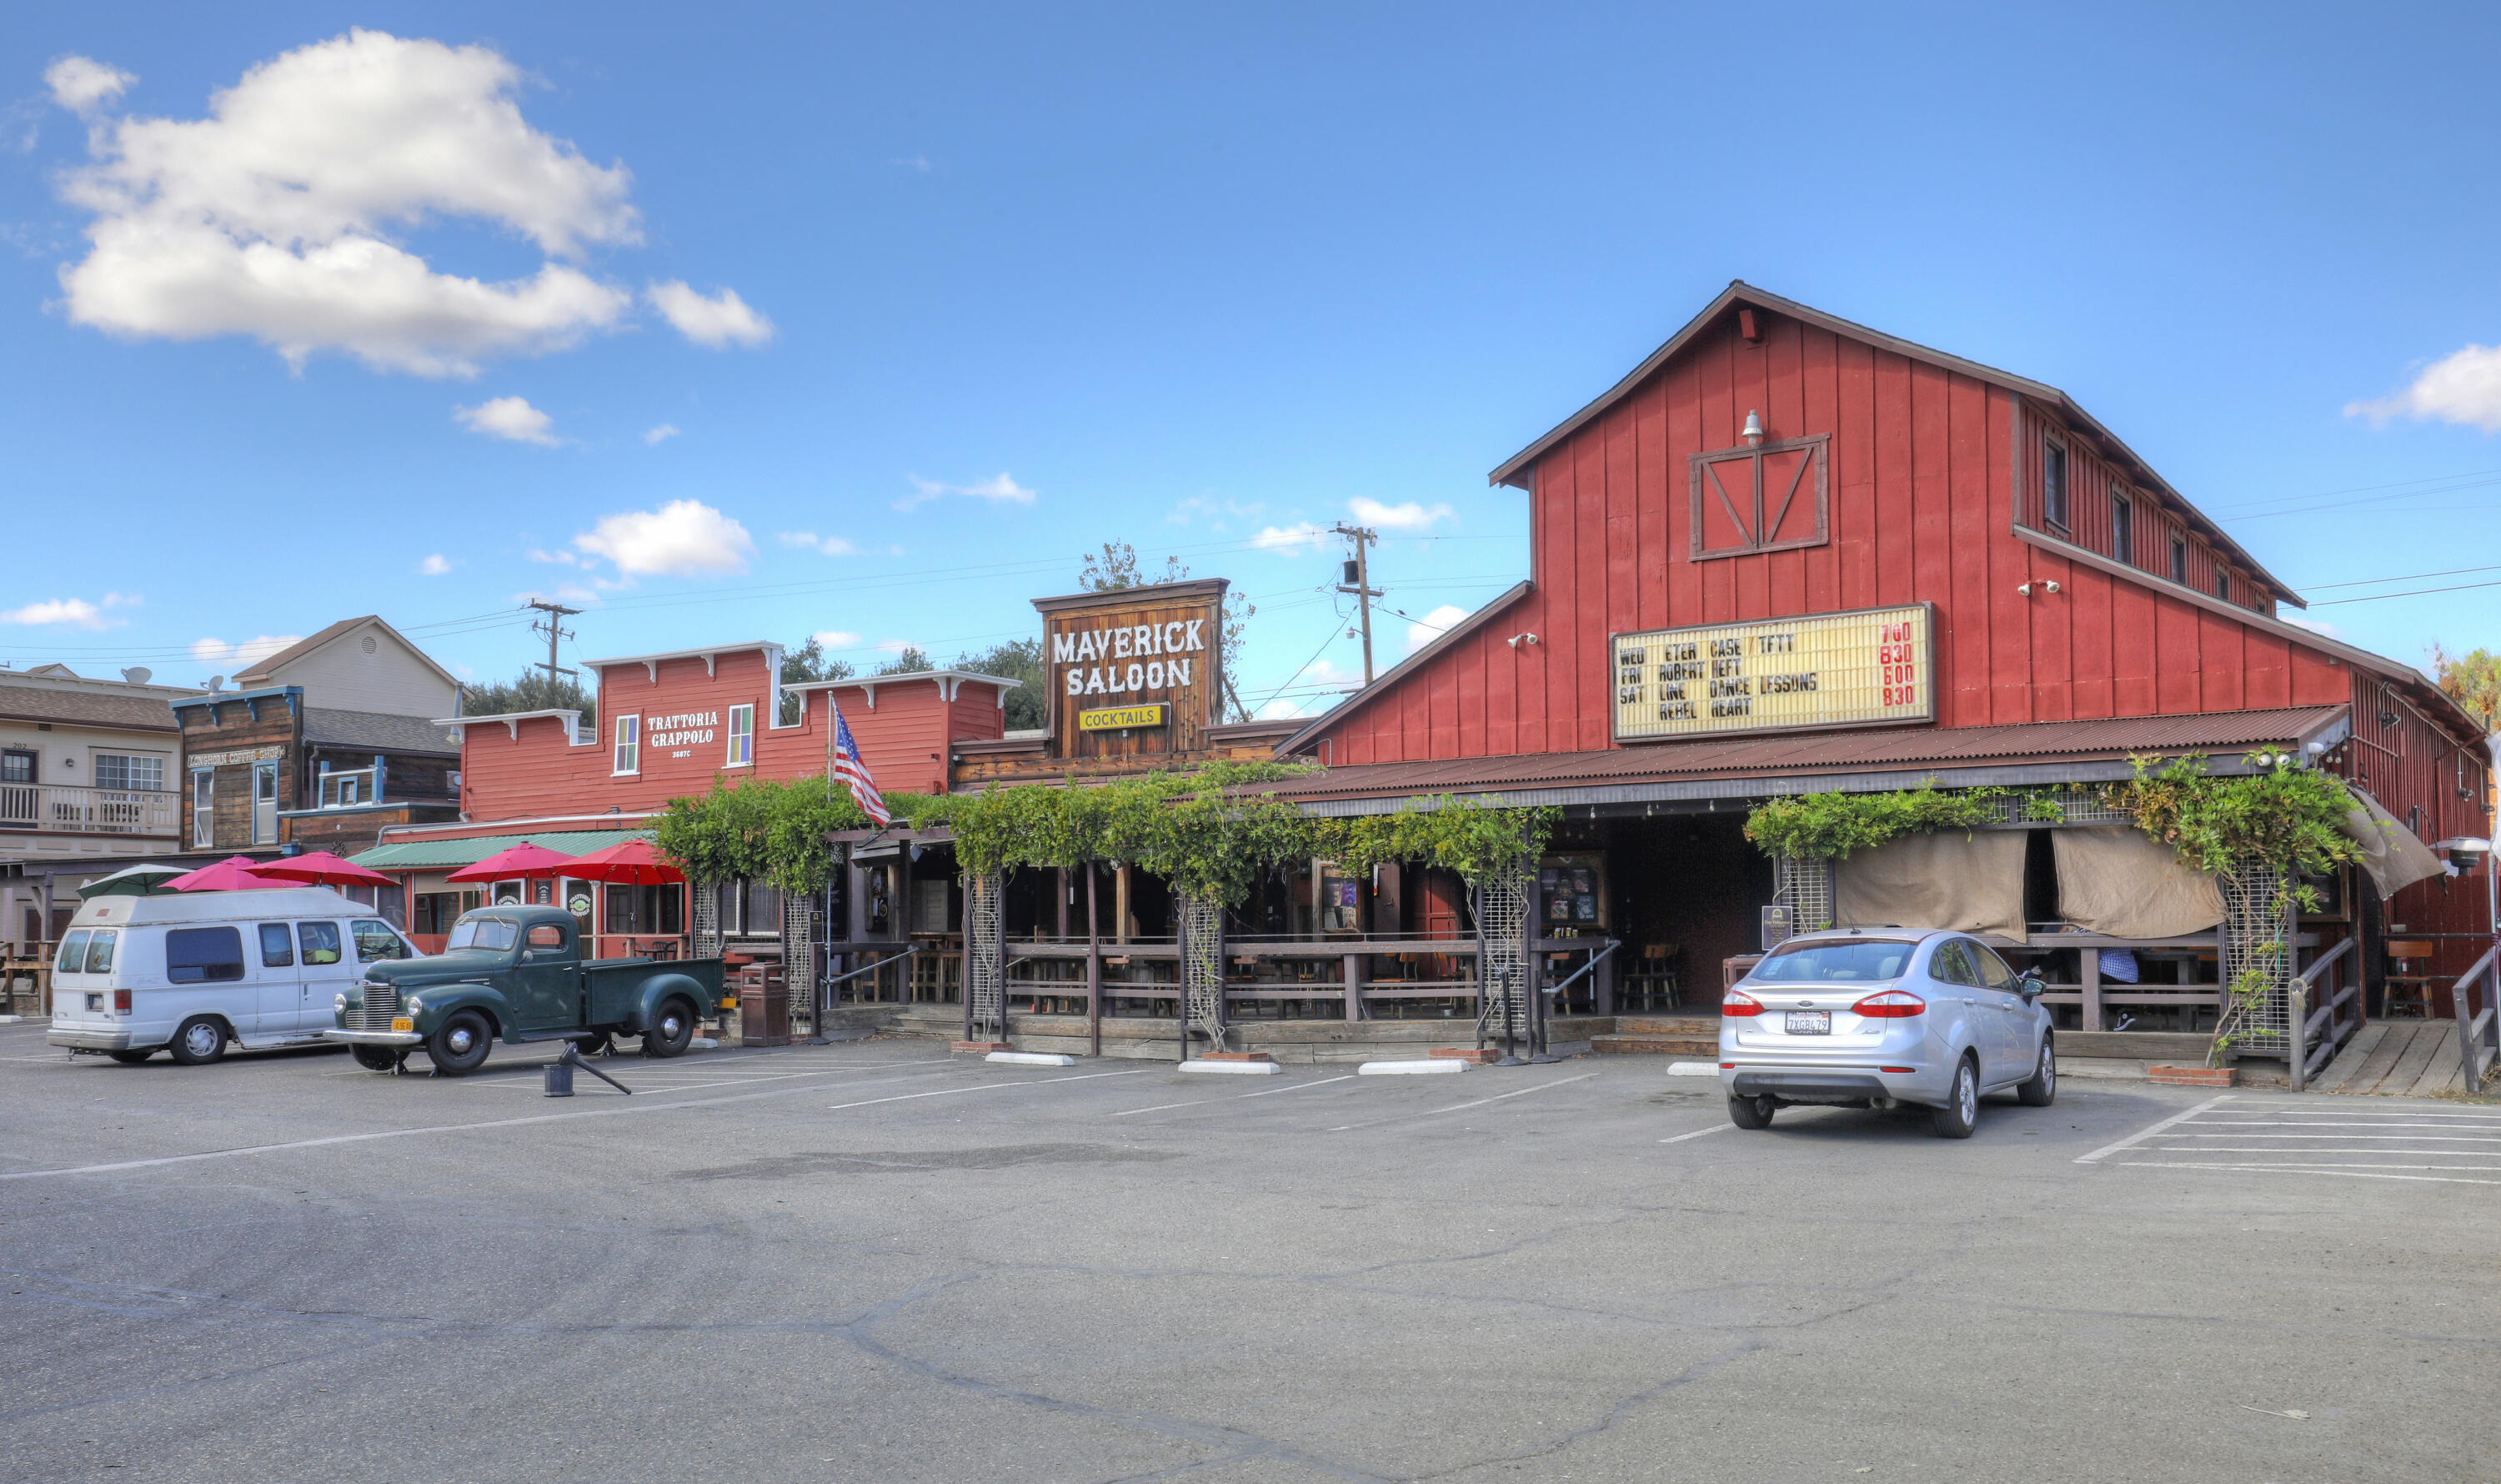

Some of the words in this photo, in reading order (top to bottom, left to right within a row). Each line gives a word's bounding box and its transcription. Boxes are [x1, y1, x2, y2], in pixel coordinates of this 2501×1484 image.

[1052, 619, 1205, 664] MAVERICK
[1619, 646, 1645, 666] WED
[1665, 642, 1697, 662] ETER
[1710, 638, 1742, 658] CASE
[1881, 622, 1911, 644] 700
[1067, 658, 1191, 696] SALOON
[1621, 666, 1641, 684] FRI
[1659, 661, 1706, 682] ROBERT
[1712, 657, 1742, 679] HEFT
[1880, 643, 1912, 664] 830
[1619, 685, 1645, 704] SAT
[1659, 682, 1686, 701] LINE
[1709, 677, 1751, 699] DANCE
[1760, 672, 1817, 694] LESSONS
[1883, 664, 1914, 685] 600
[648, 711, 719, 731] TRATTORIA
[1085, 709, 1155, 727] COCKTAILS
[1659, 701, 1697, 721] REBEL
[1711, 697, 1752, 718] HEART
[1882, 685, 1914, 706] 830
[190, 754, 227, 766] LONGHORN
[259, 746, 281, 760] SHOP
[651, 729, 714, 748] GRAPPOLO
[1788, 1020, 1827, 1030] 7XGB479
